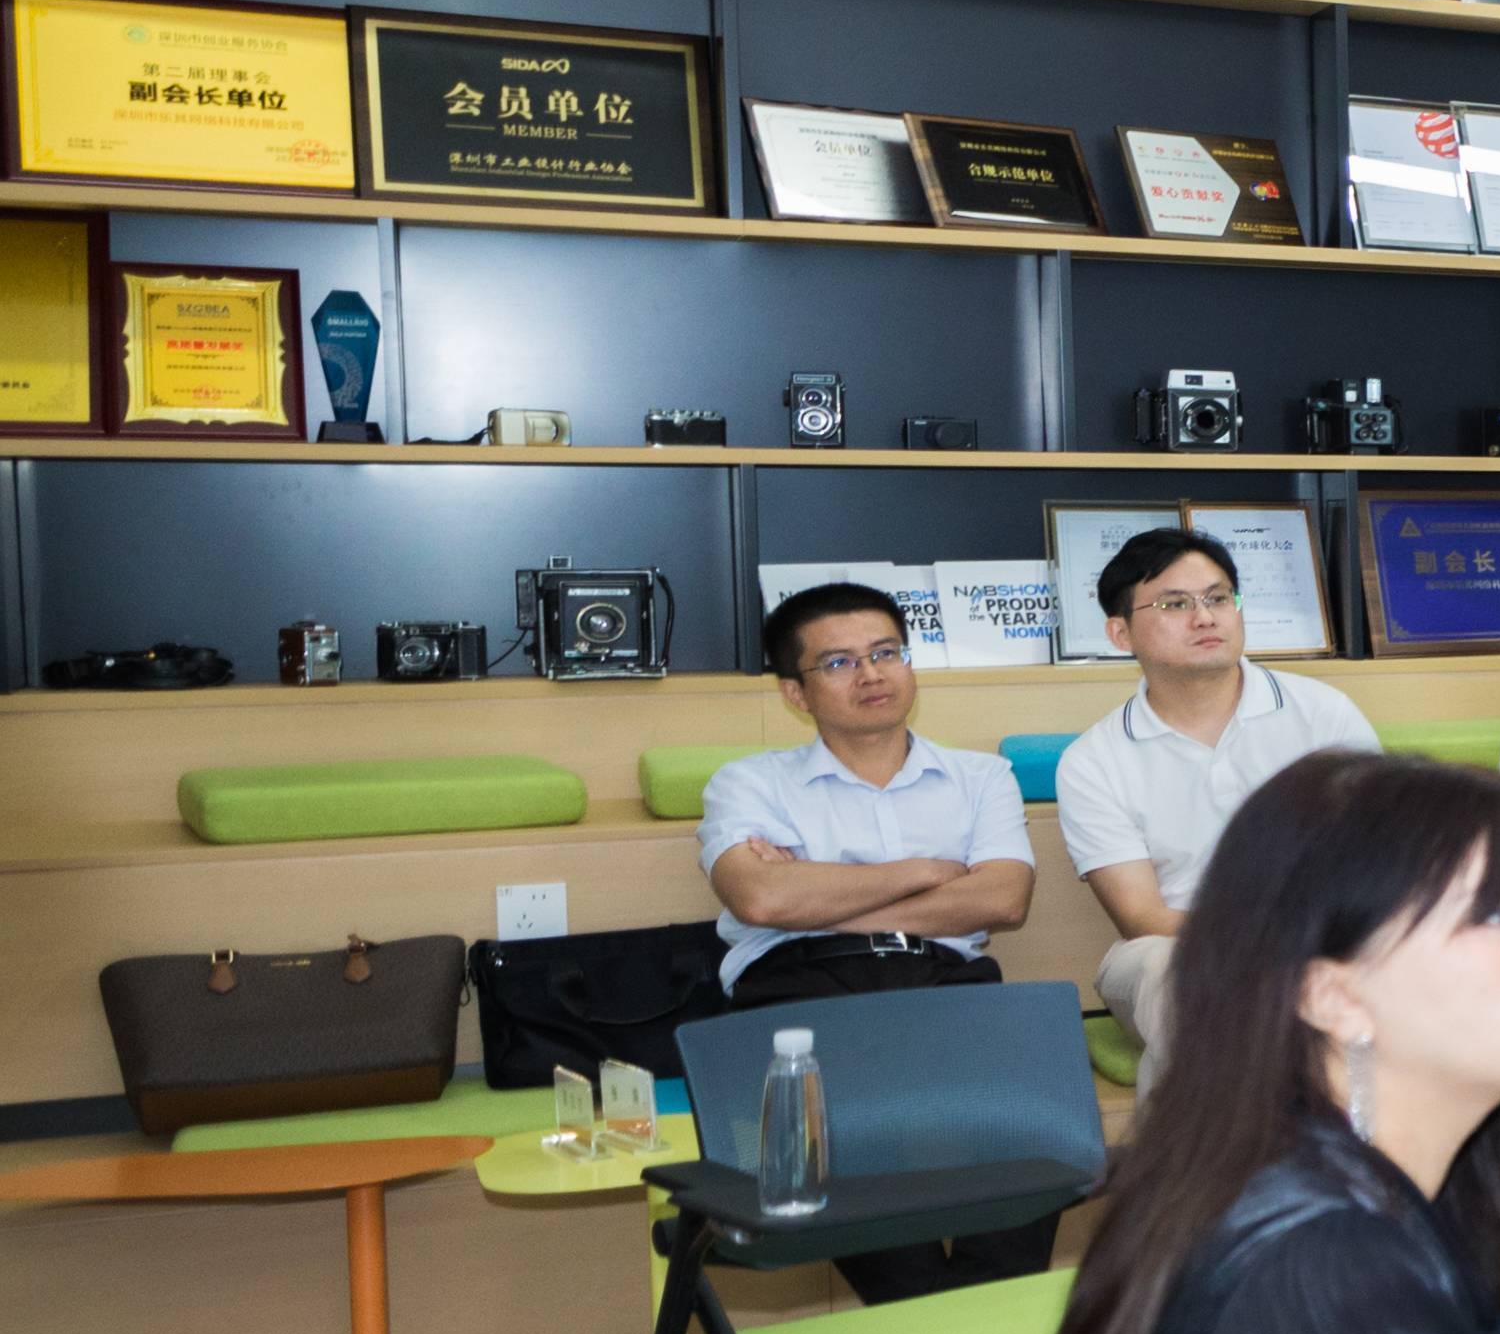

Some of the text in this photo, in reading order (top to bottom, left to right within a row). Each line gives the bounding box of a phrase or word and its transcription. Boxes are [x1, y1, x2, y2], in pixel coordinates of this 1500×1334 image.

[142, 62, 273, 85] 第二届理事会
[501, 58, 540, 71] SIDA
[129, 81, 289, 111] 副会长单位
[443, 81, 634, 125] 会员单位
[502, 123, 579, 140] MEMBER
[968, 162, 1055, 184] 合规示范单位
[985, 597, 1058, 611] PRODUC
[988, 613, 1037, 626] YEAR
